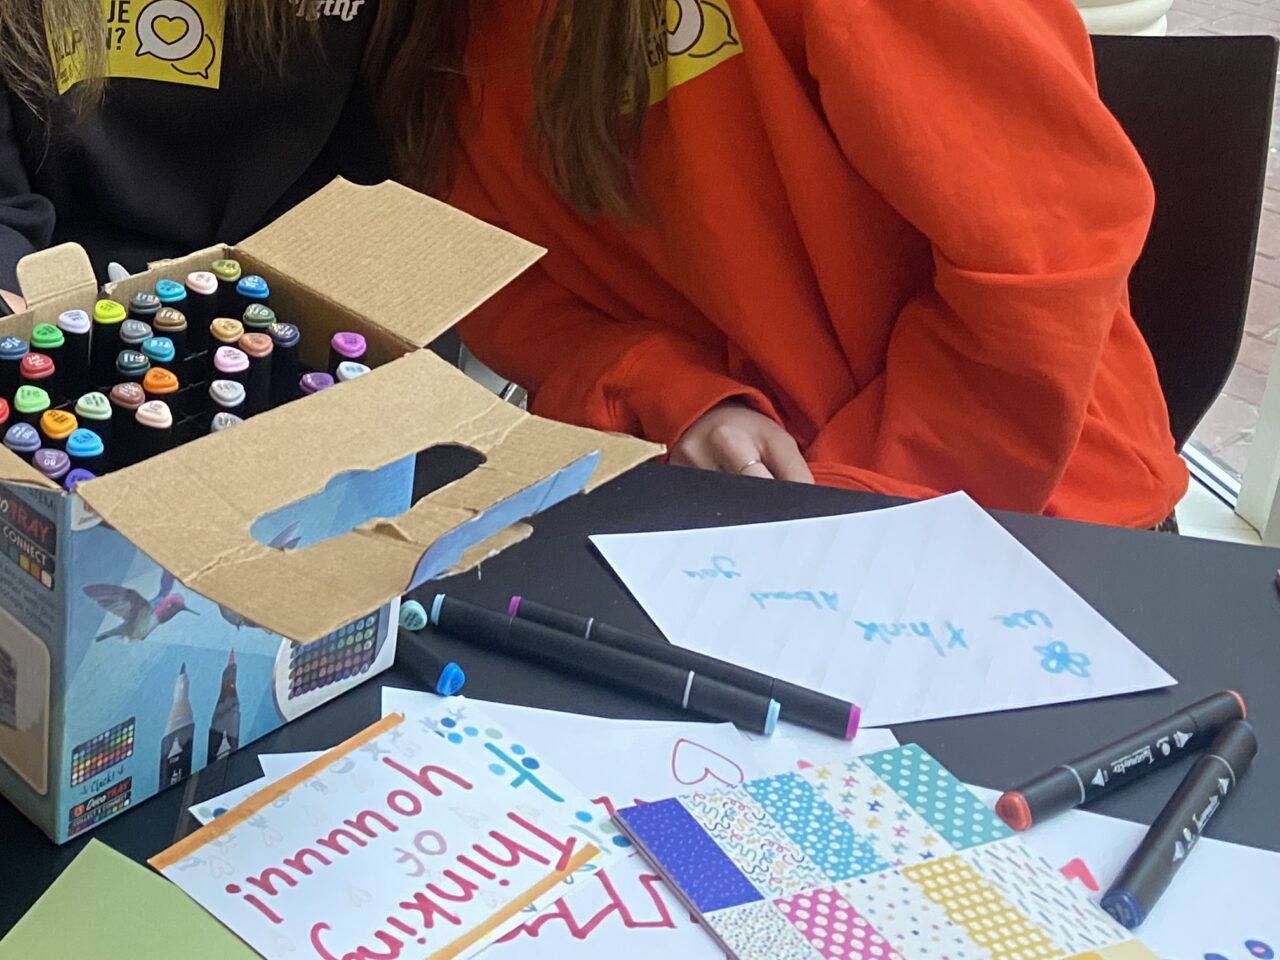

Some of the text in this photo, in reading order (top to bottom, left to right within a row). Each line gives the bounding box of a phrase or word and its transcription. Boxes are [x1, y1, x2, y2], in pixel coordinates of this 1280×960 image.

[107, 0, 131, 23] JE
[2, 526, 47, 566] CONNECT
[225, 756, 474, 924] youuuu!
